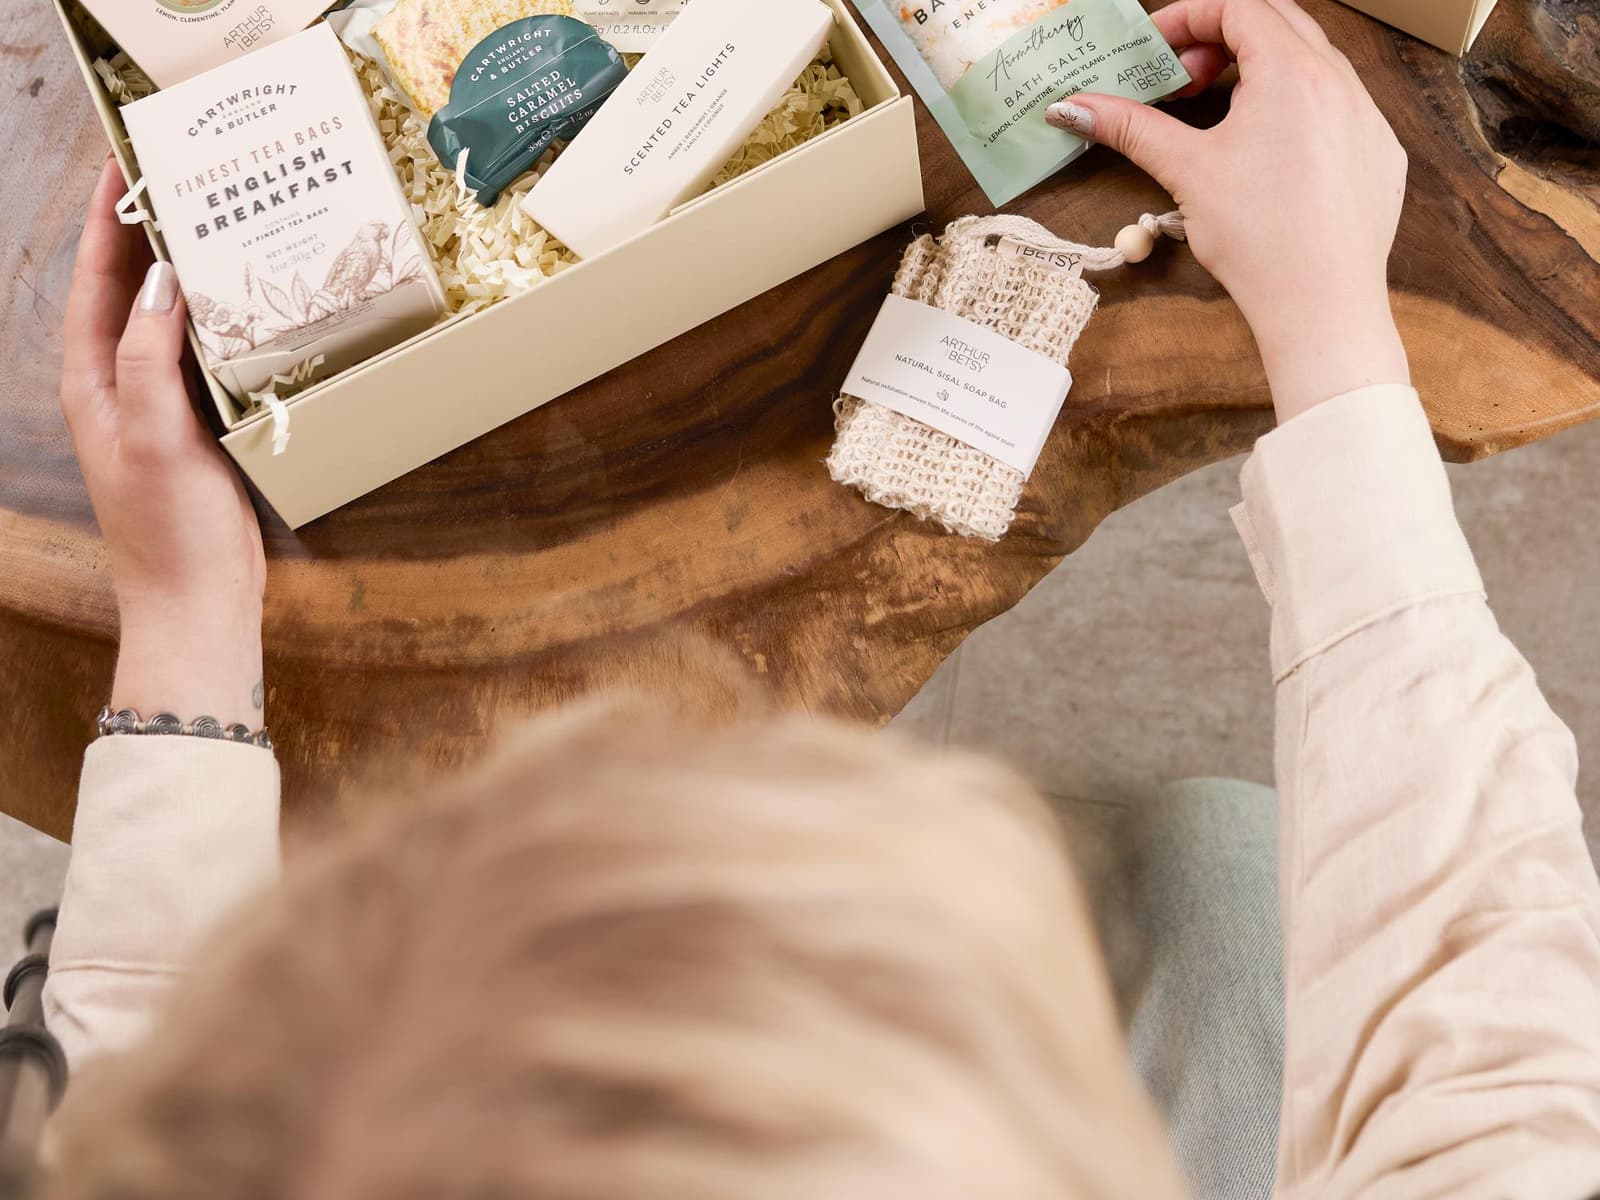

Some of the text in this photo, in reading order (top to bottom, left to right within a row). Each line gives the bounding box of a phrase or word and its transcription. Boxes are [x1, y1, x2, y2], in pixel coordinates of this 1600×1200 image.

[154, 6, 178, 22] LEMON,
[180, 11, 218, 22] CLEMENTINE,
[223, 5, 269, 48] ARTHUR
[614, 24, 629, 34] 0.2
[471, 29, 550, 81] CARTWRIGHT
[488, 44, 543, 81] & BUTLER
[496, 45, 524, 65] ENGLAND
[986, 15, 1084, 92] Aromatherapy
[1004, 41, 1096, 108] BATH SALTS
[1114, 53, 1172, 85] ARTHUR
[507, 69, 560, 108] SALTED
[507, 78, 576, 122] CARAMEL
[635, 67, 670, 105] ARTHUR
[988, 119, 1014, 143] LEMON,
[1011, 83, 1055, 123] CLEMENTINE,
[1054, 69, 1080, 86] YLANG
[1080, 53, 1106, 72] YLANG
[1110, 32, 1152, 55] PATCHOULI
[1079, 73, 1099, 88] OILS
[188, 84, 296, 136] CARTWRIGHT
[214, 104, 276, 136] & BUTLER
[514, 87, 582, 134] BISCUITS
[624, 43, 735, 175] SCENTED TEA LIGHTS
[175, 116, 342, 197] FINEST TEA BAGS
[207, 147, 325, 208] ENGLISH
[195, 161, 352, 238] BREAKFAST
[256, 226, 284, 241] FINEST
[288, 218, 303, 226] TEA
[306, 205, 328, 219] BAGS
[264, 232, 317, 259] NET WEIGHT
[940, 335, 990, 364] ARTHUR
[895, 354, 1008, 408] NATURAL SISAL SOAP BAG
[861, 374, 881, 385] Natural
[880, 382, 908, 397] exfoliation
[950, 411, 968, 424] leaves
[975, 423, 984, 432] the
